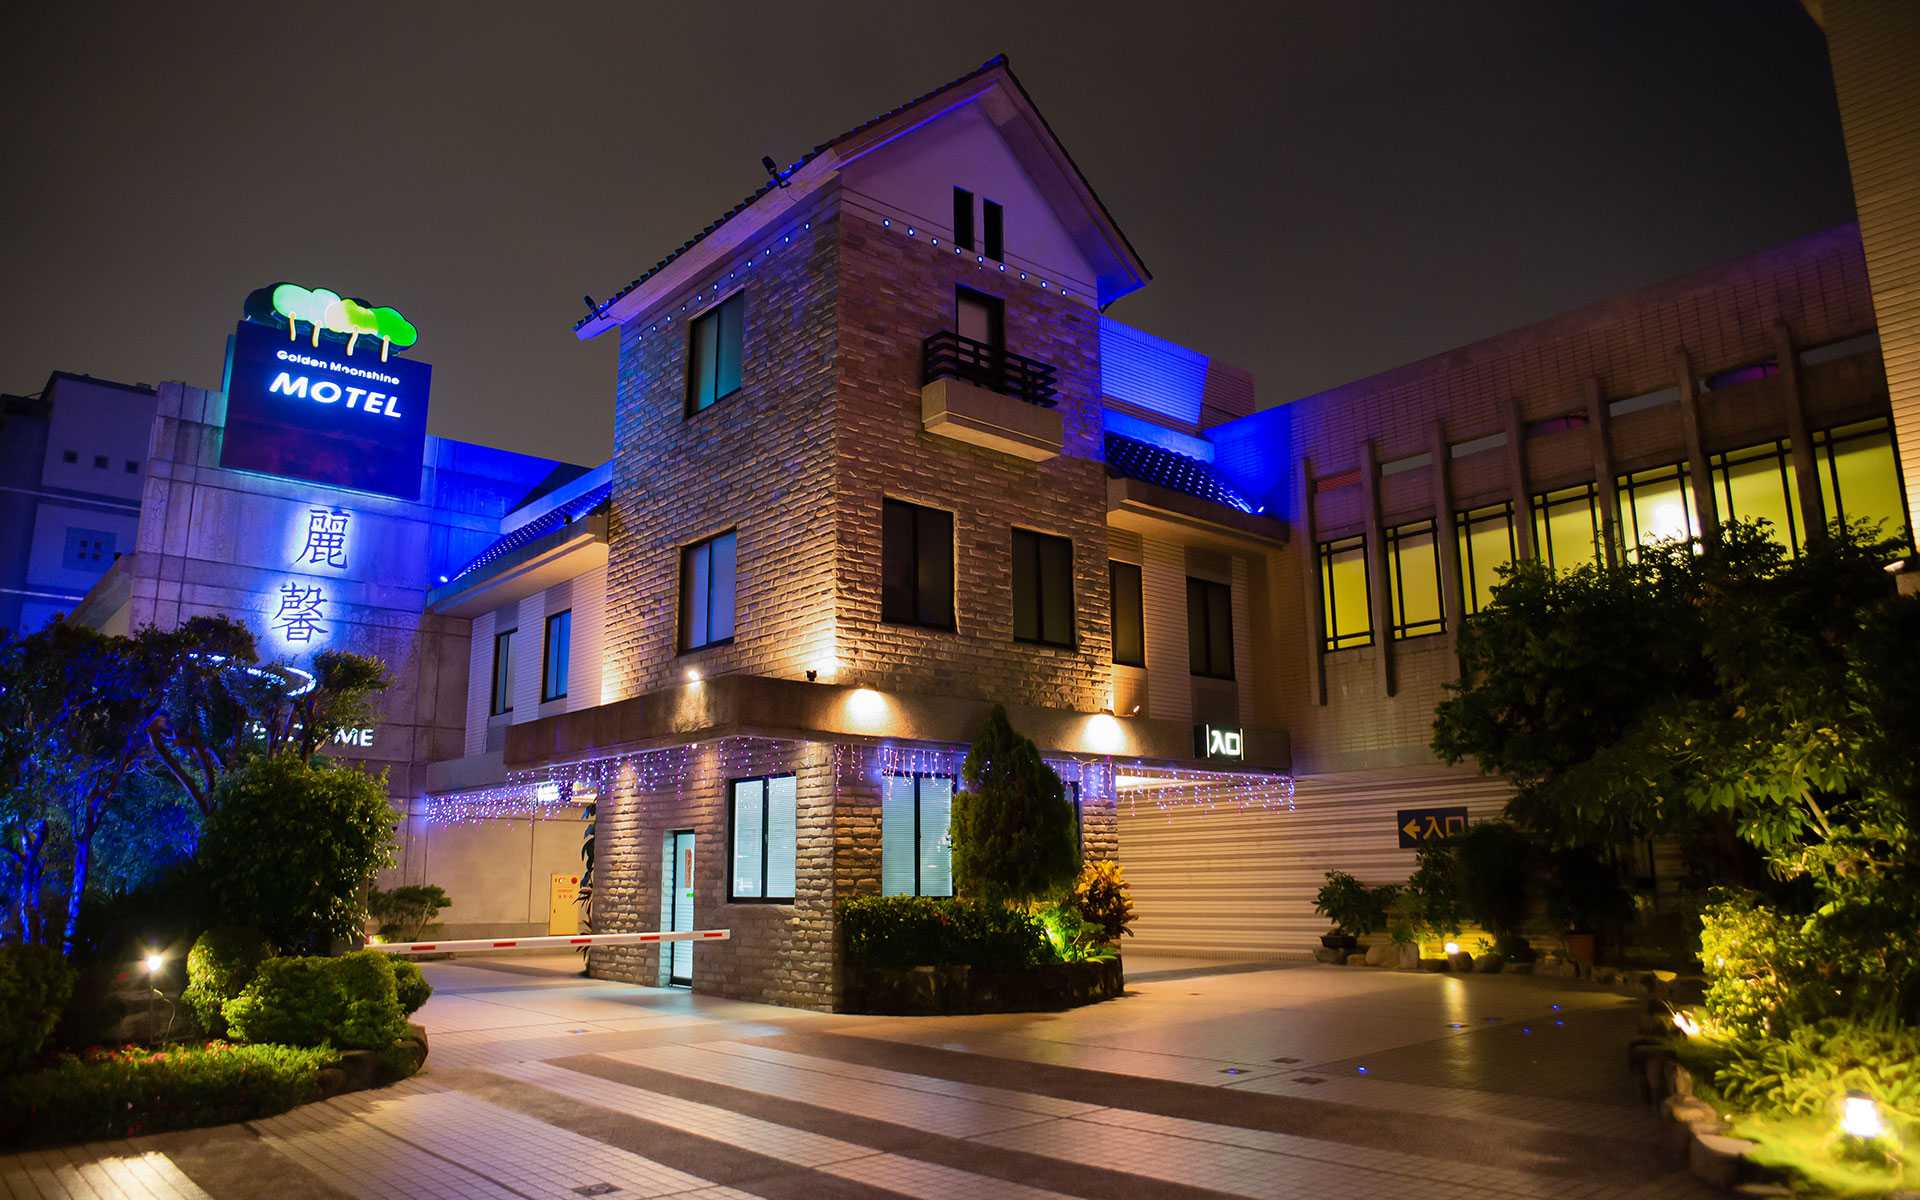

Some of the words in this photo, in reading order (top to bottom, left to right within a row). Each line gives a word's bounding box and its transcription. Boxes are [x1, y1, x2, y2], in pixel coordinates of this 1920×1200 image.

[276, 350, 328, 369] Golden
[329, 361, 400, 385] Moonshine
[269, 371, 402, 418] MOTEL
[271, 508, 351, 644] 麗馨
[1210, 729, 1241, 756] 入口
[1422, 815, 1465, 839] 入口
